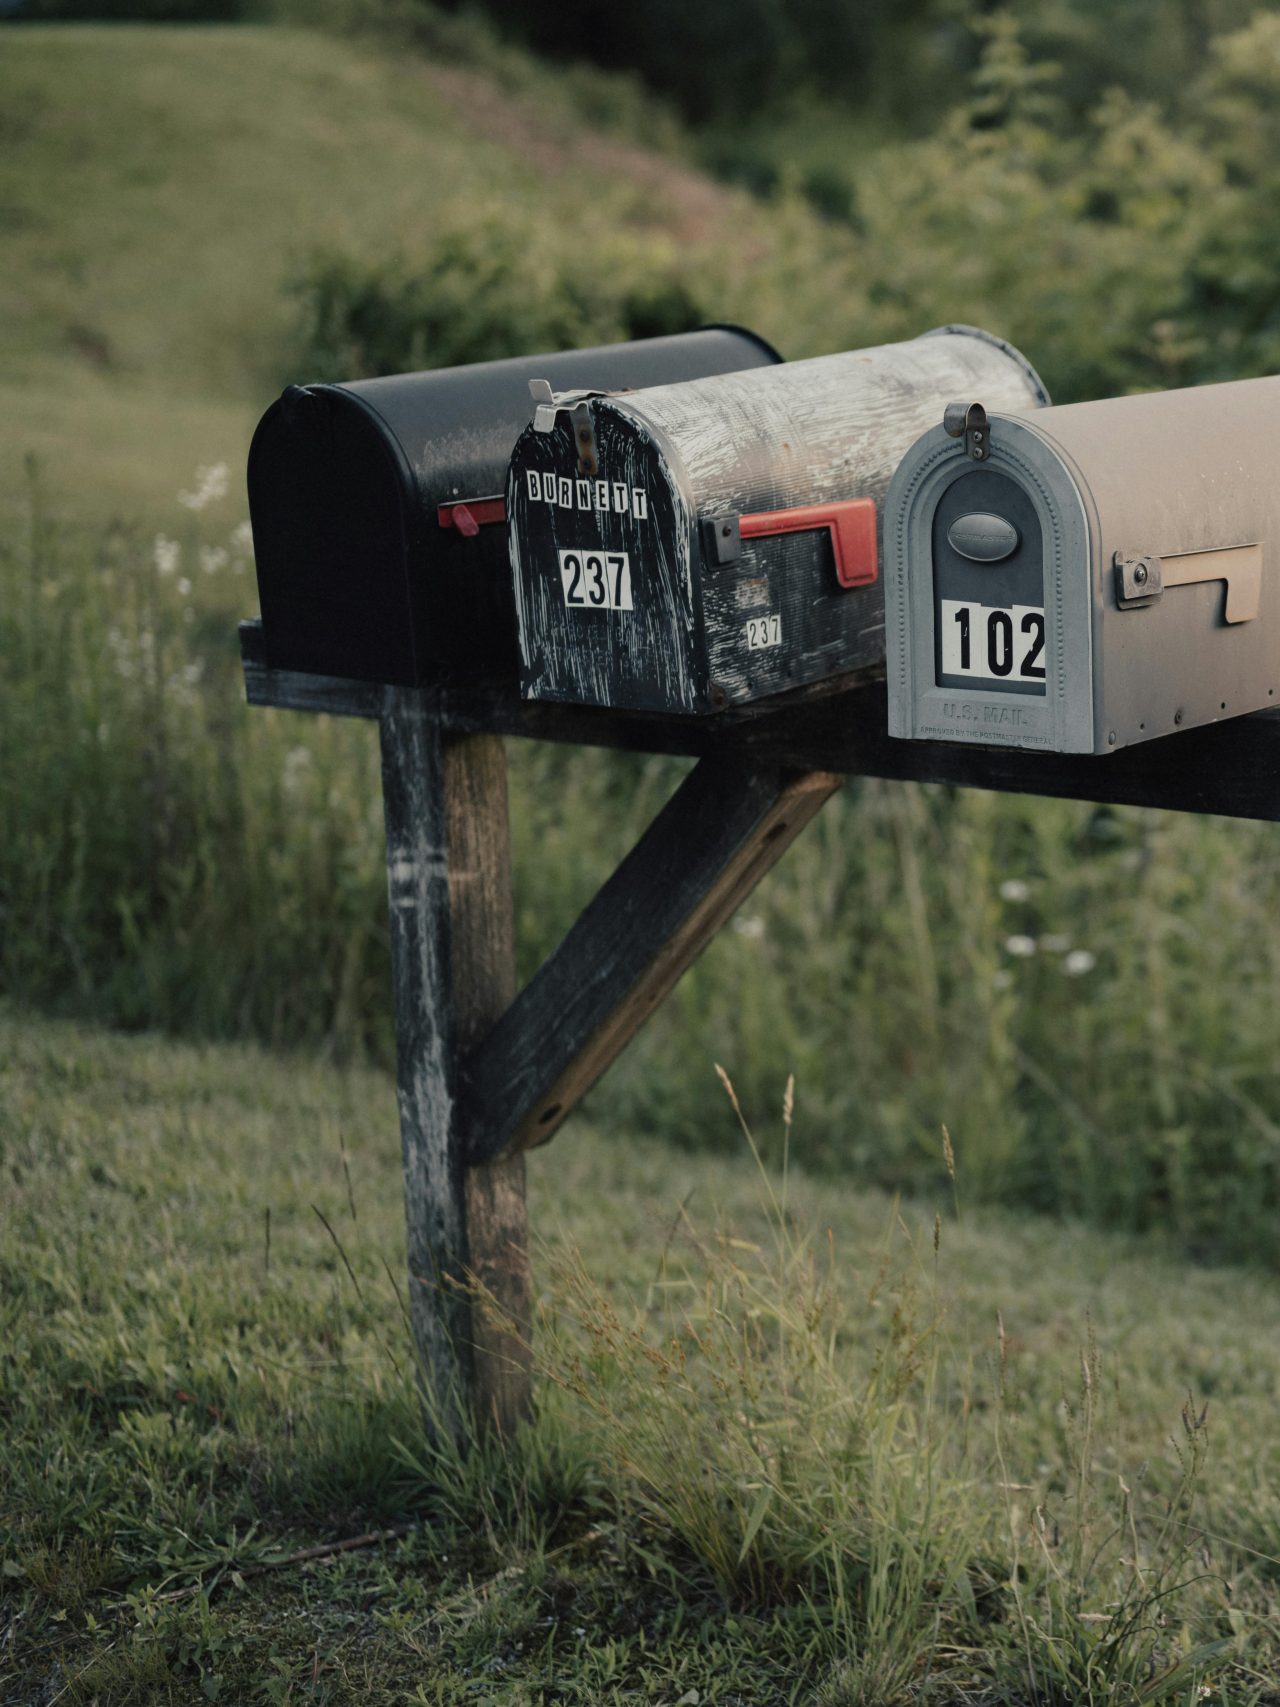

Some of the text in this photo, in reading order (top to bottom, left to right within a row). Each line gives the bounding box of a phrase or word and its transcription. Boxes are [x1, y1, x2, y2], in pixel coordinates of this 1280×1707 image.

[528, 472, 646, 518] BURNETT
[563, 553, 625, 607] 237
[749, 618, 779, 647] 237
[954, 606, 1046, 678] 102
[943, 703, 1029, 727] U.S. MAIL
